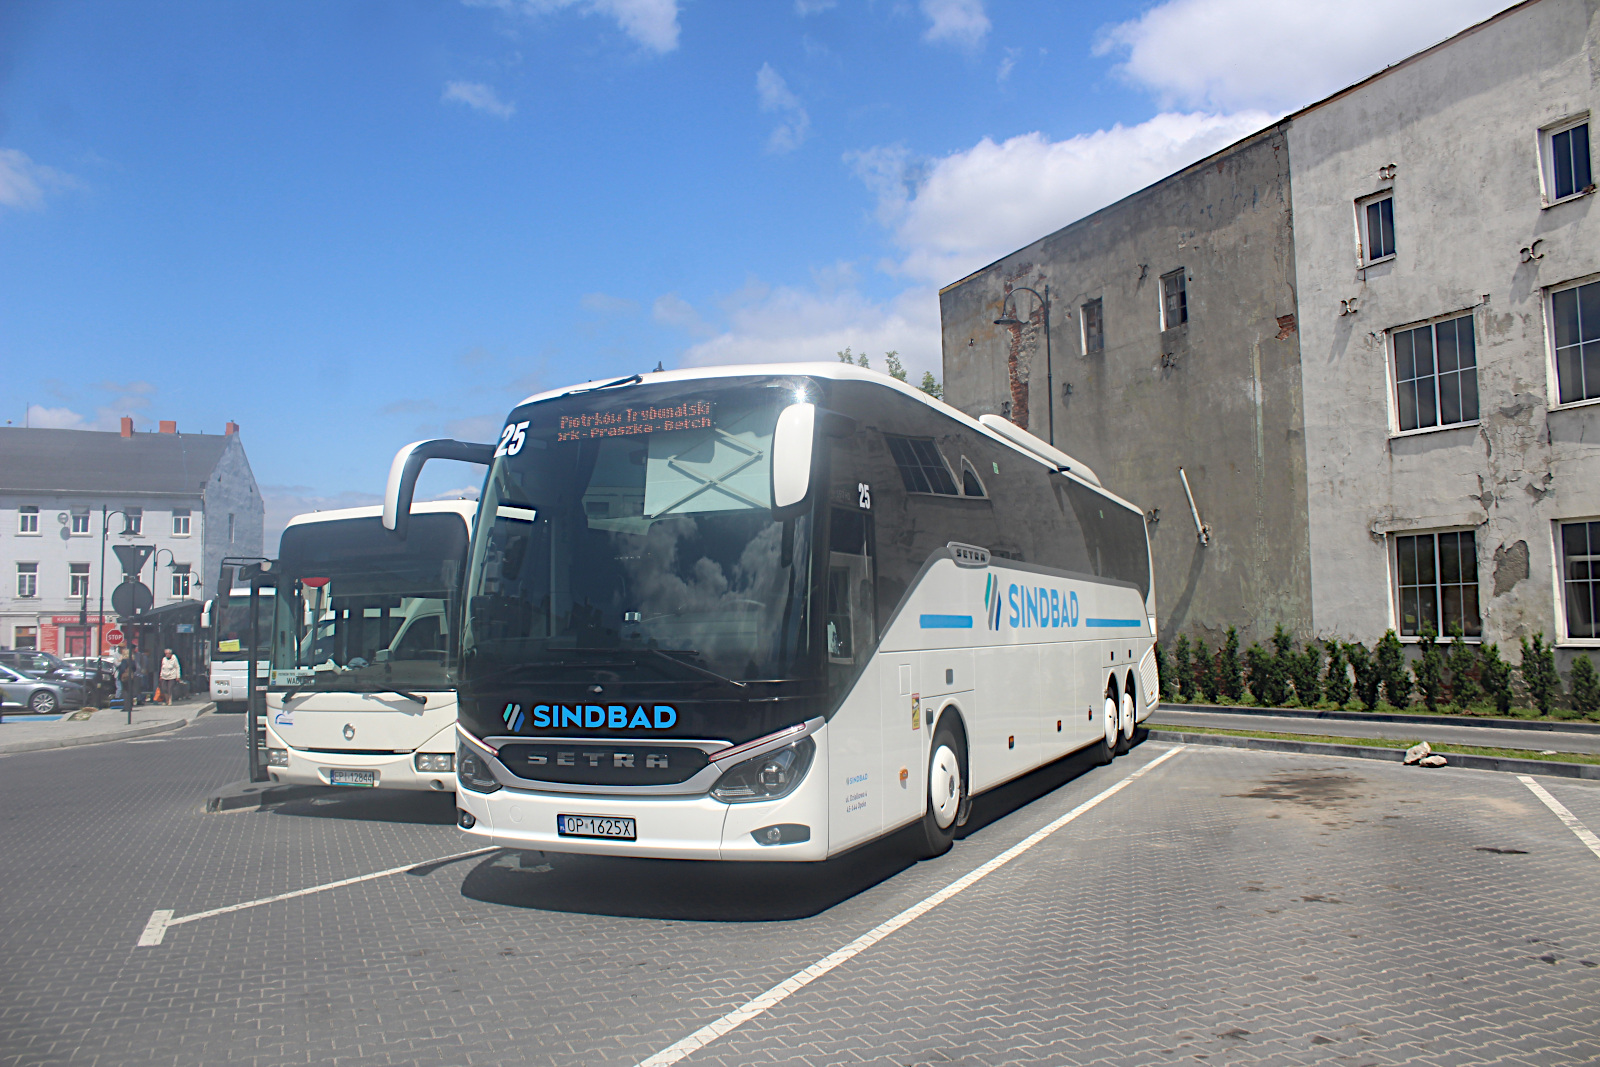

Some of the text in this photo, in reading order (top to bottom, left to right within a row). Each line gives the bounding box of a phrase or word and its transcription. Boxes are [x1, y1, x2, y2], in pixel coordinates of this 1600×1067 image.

[561, 401, 710, 429] Piotrków Trybunalski
[494, 420, 531, 458] 25
[590, 423, 653, 438] Praszka
[858, 483, 871, 509] 25
[956, 549, 986, 562] SETRA
[1008, 583, 1079, 628] SINDBAD
[533, 704, 677, 729] SINDBAD
[527, 752, 669, 768] SETRA
[350, 772, 372, 783] 12844
[567, 817, 631, 836] OP 1625X
